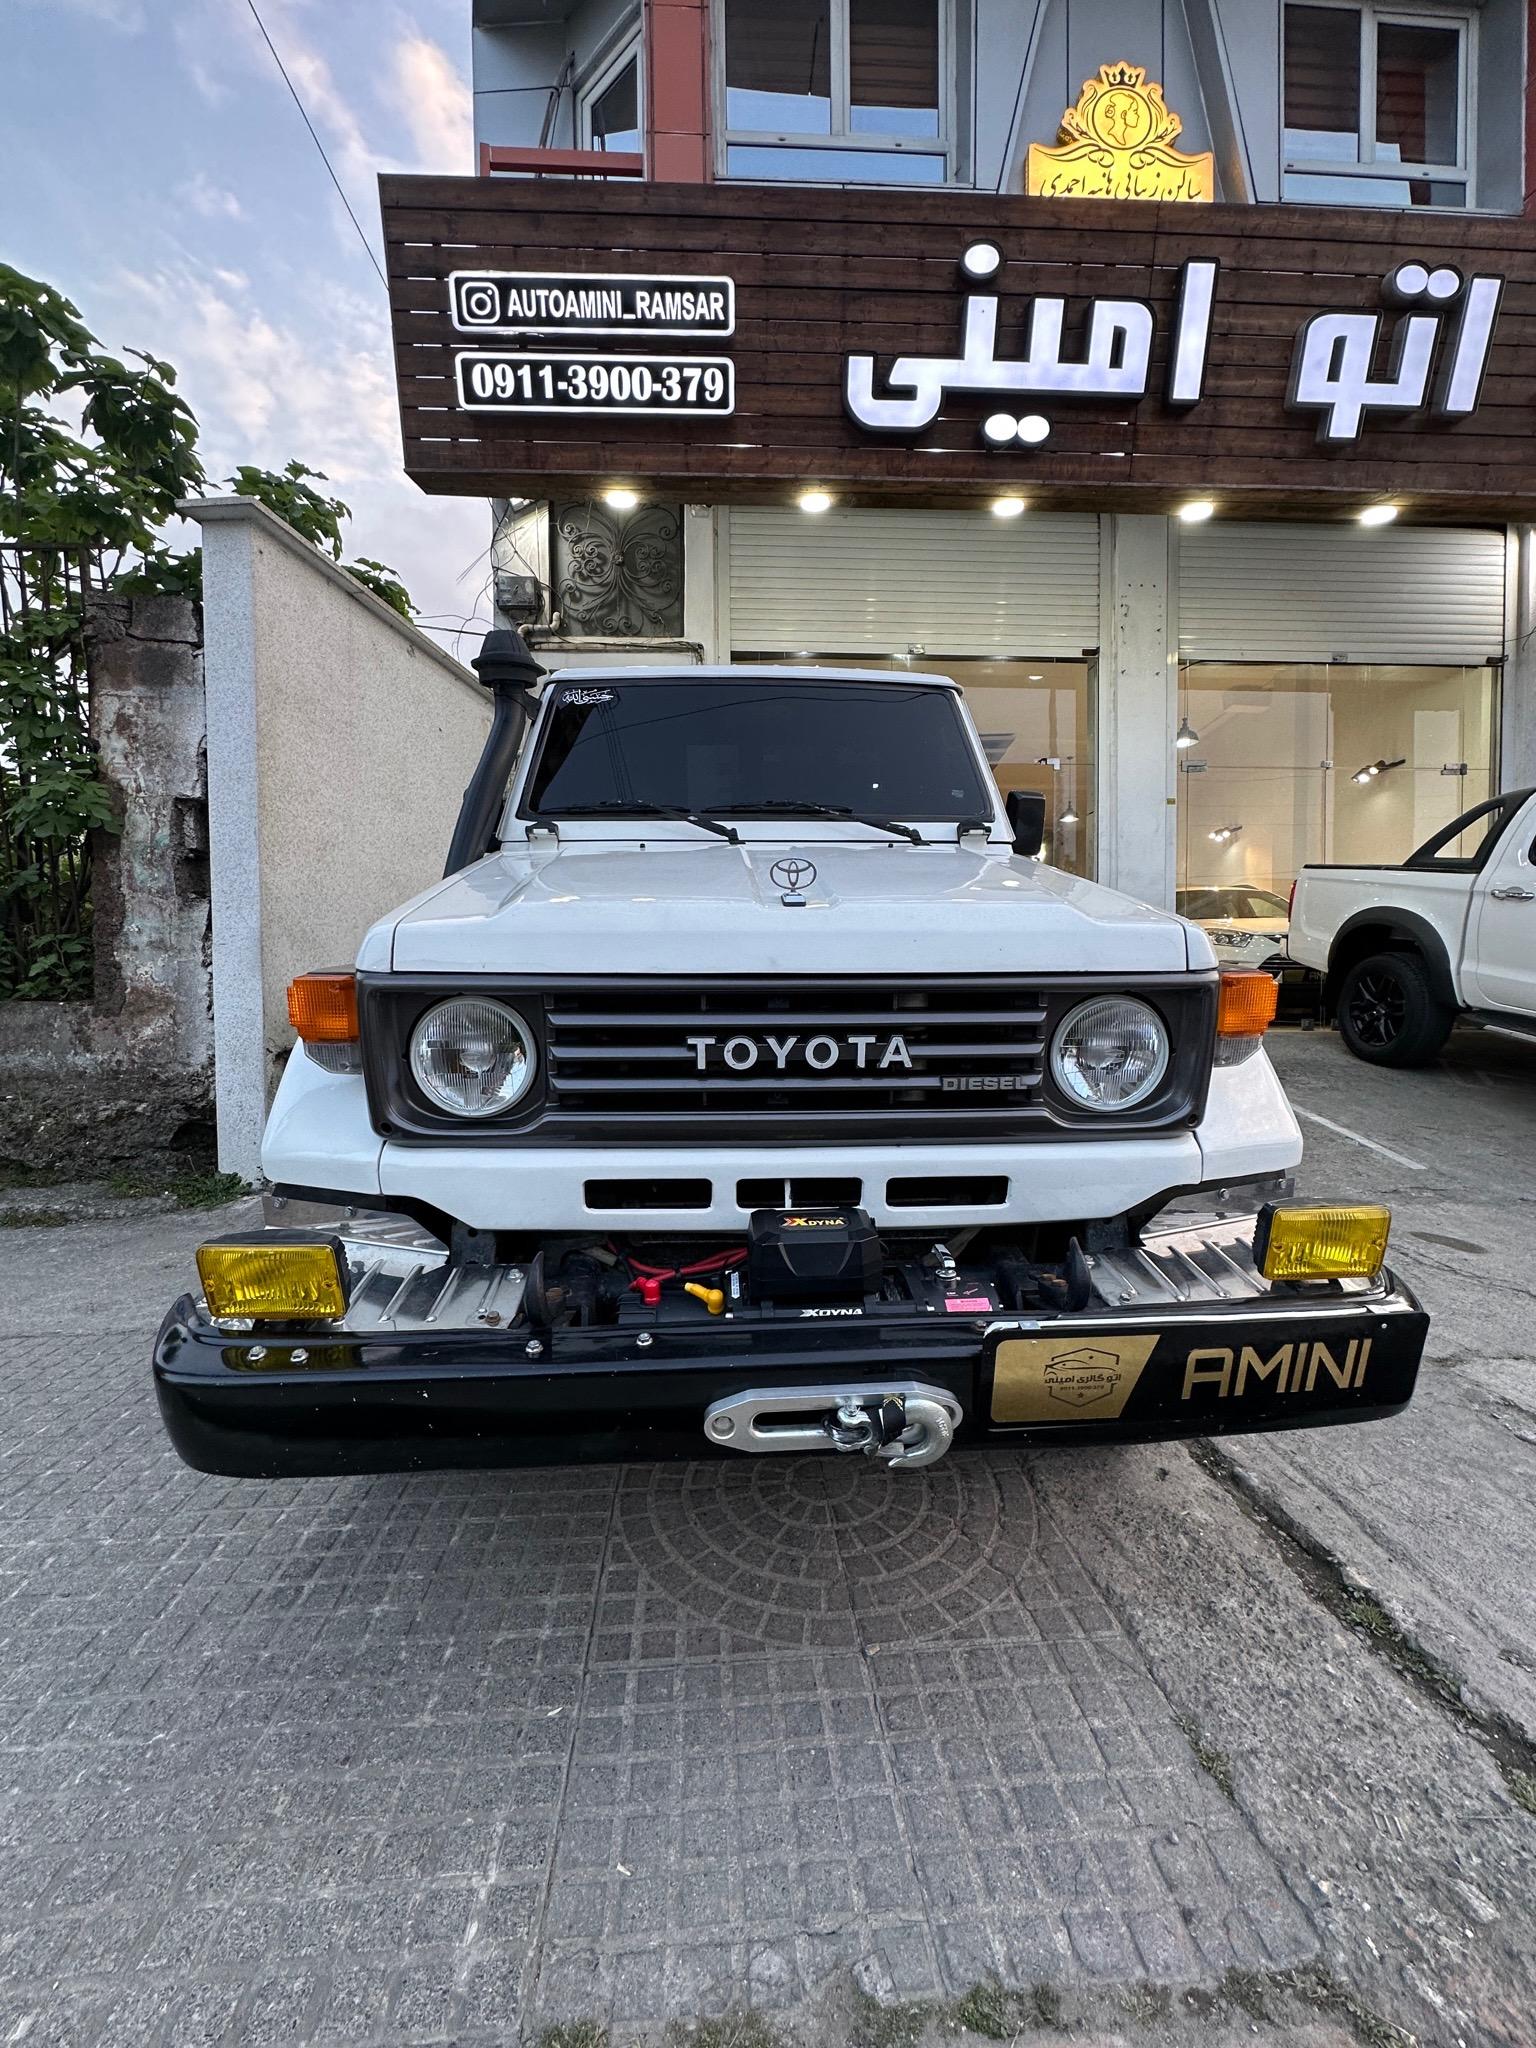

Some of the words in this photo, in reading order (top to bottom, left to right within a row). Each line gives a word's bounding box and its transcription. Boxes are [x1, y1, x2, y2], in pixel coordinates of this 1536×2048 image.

[507, 288, 725, 321] AUTOAMINI_RAMSAR
[847, 242, 1218, 443] امینی
[1296, 264, 1503, 440] اتو
[471, 362, 724, 402] 0911-3900-379
[686, 1035, 913, 1070] TOYOTA
[942, 1076, 1028, 1091] DIESEL
[1181, 1337, 1373, 1400] AMINI
